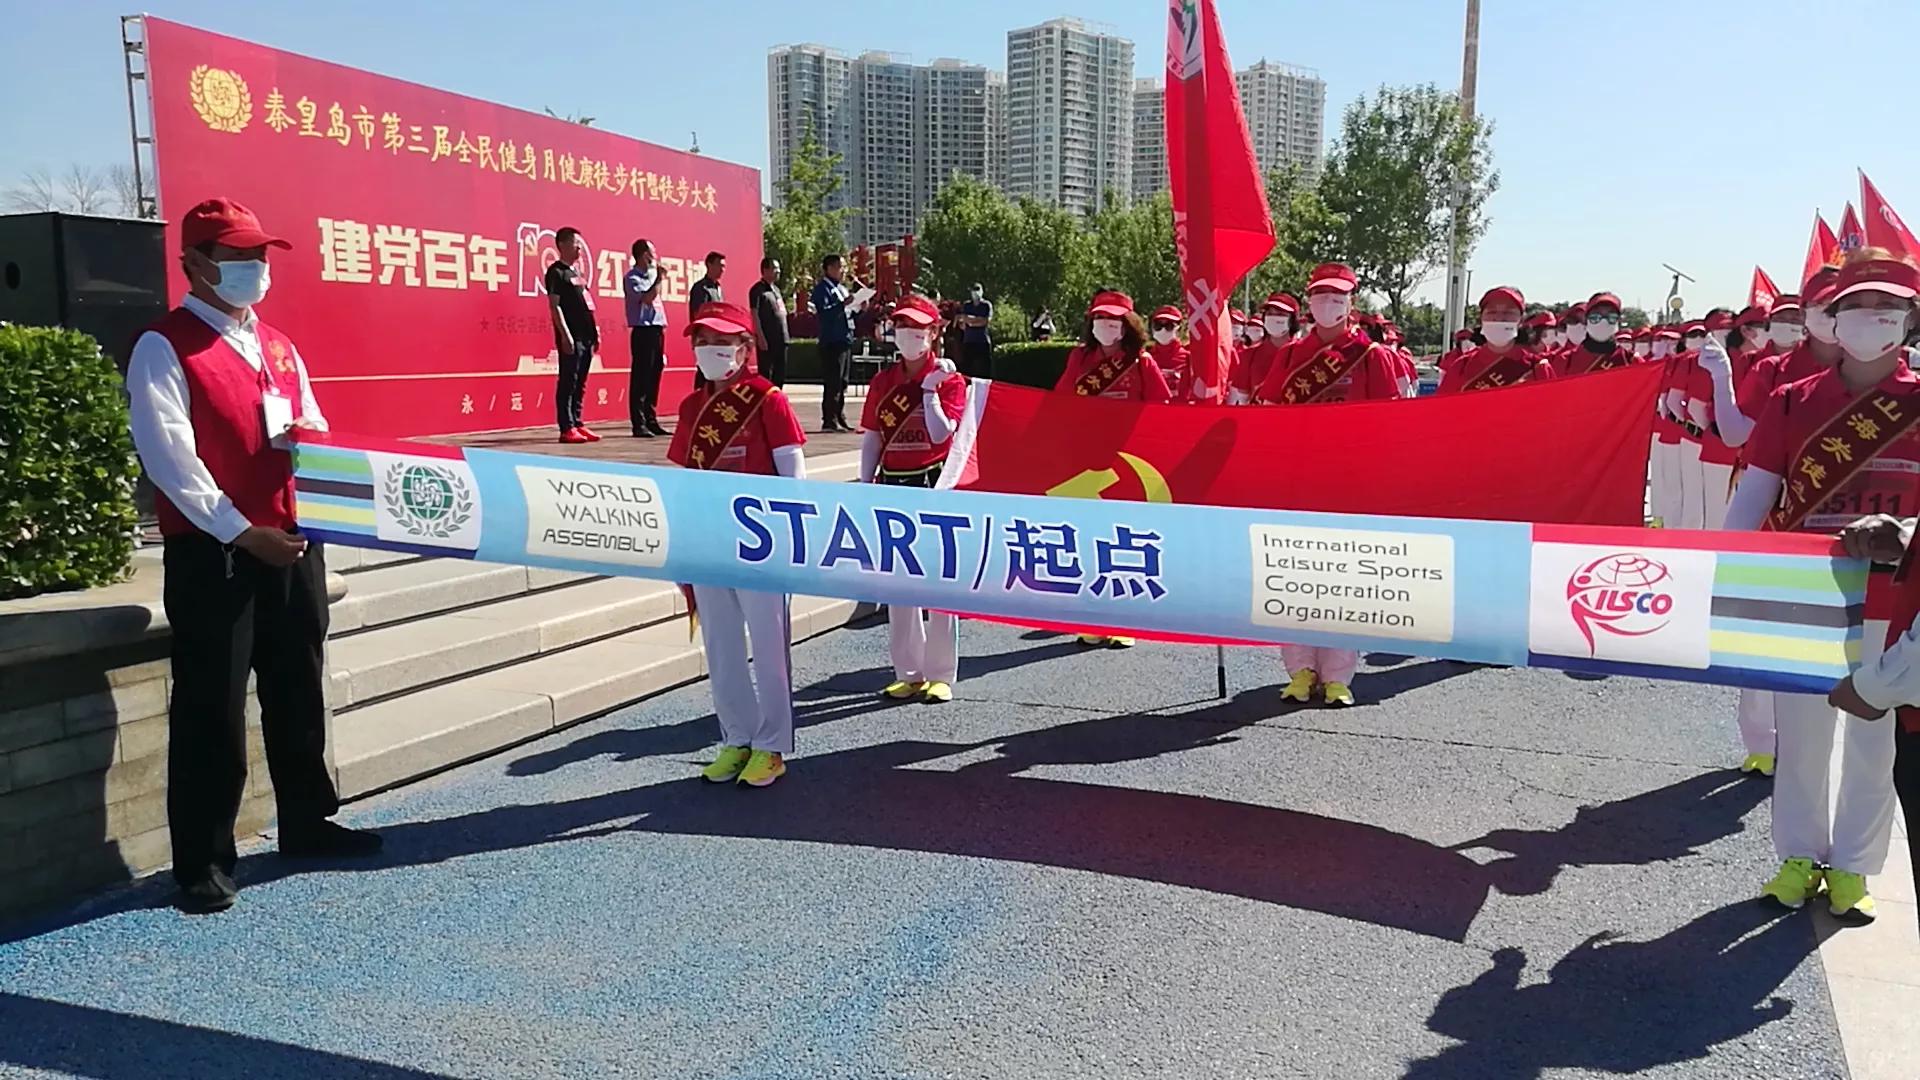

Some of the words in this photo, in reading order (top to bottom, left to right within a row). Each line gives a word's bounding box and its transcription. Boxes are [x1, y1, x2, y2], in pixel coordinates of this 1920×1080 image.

[318, 217, 510, 292] 建党百年
[548, 478, 652, 504] WORLD
[556, 501, 660, 530] WALKING
[542, 528, 661, 554] ASSEMBLY
[1263, 533, 1408, 556] International
[1265, 553, 1348, 573] Leisure
[1358, 559, 1443, 582] Sports
[1265, 575, 1410, 602] Cooperation
[1264, 598, 1415, 627] Organization
[1594, 589, 1673, 616] ILSCO
